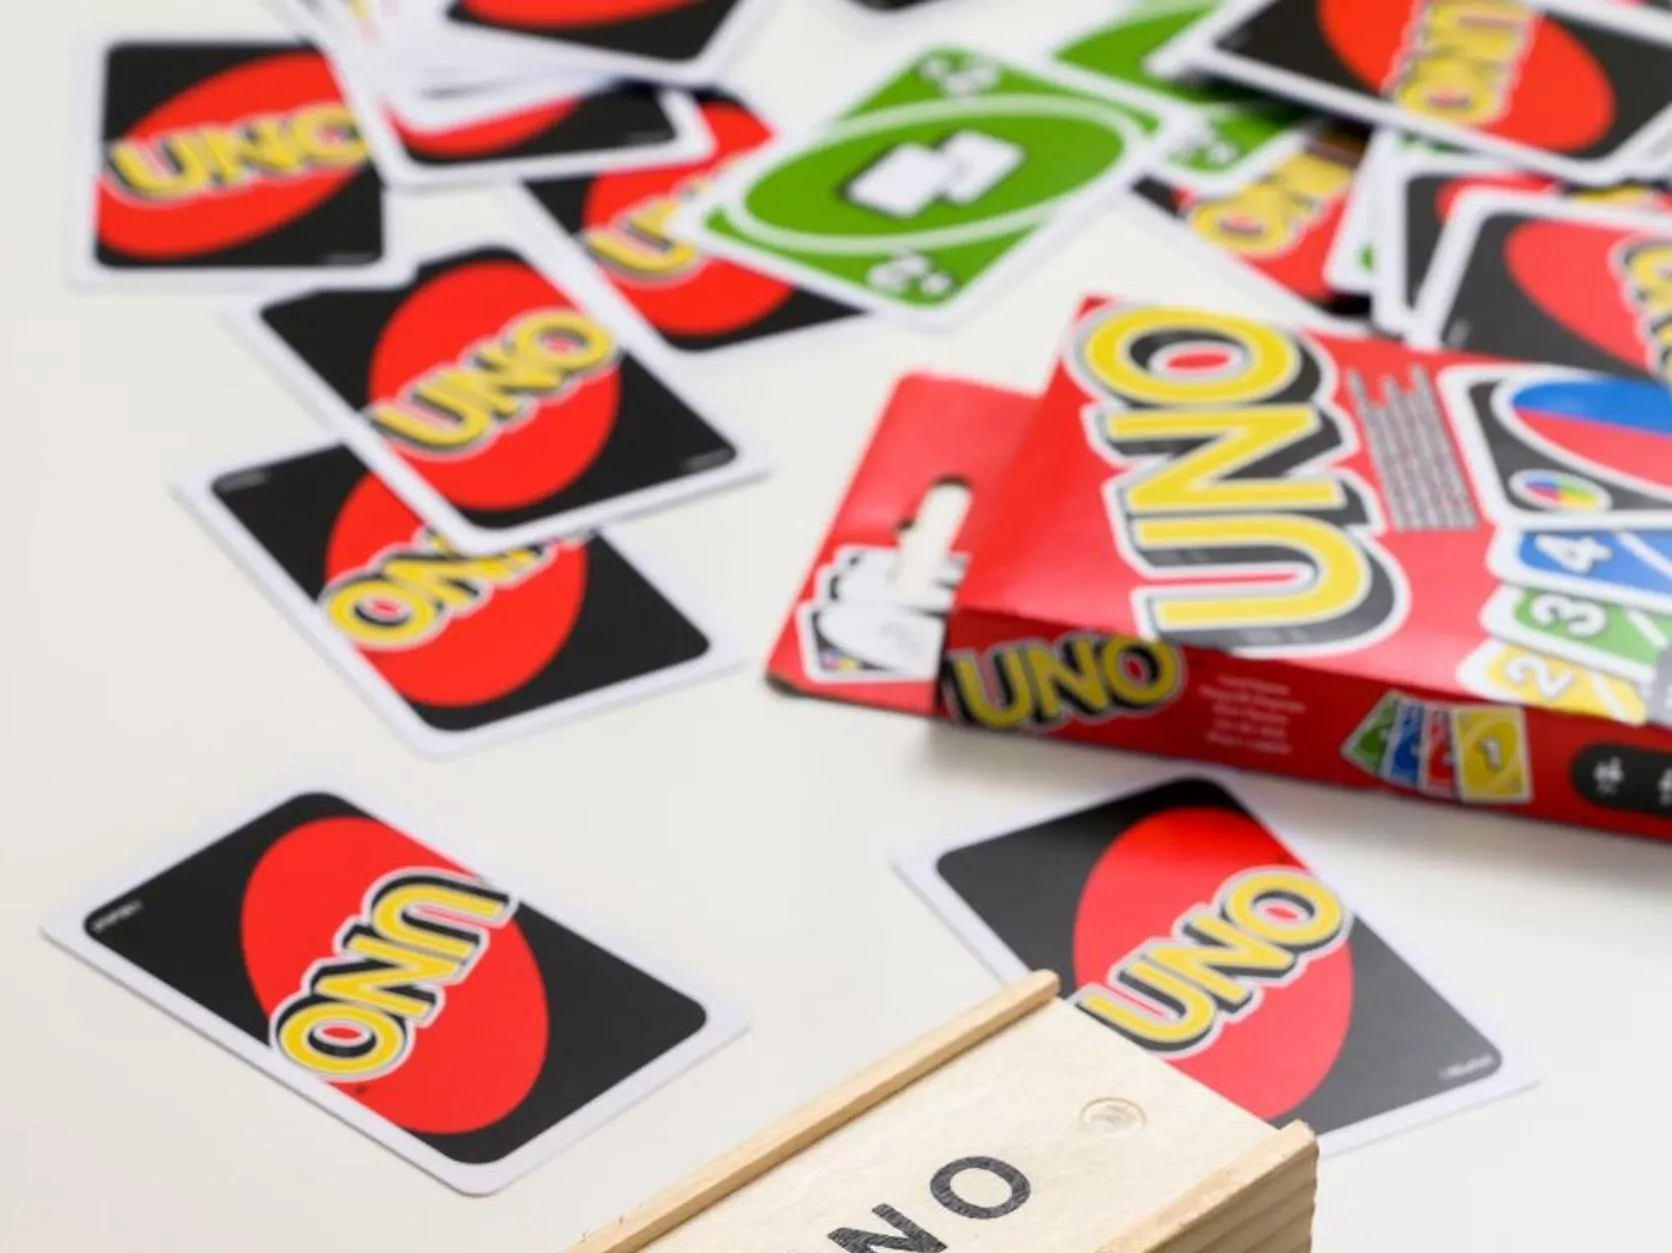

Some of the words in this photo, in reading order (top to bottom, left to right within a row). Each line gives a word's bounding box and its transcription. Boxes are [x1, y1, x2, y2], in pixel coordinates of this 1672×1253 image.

[108, 102, 368, 203] UNO
[360, 304, 618, 460] UNO
[1064, 300, 1410, 658] UNO
[320, 525, 560, 651] NO
[1535, 534, 1612, 575] 4
[1530, 593, 1606, 638] 3
[942, 632, 1186, 733] UNO
[1505, 656, 1574, 698] 2
[270, 866, 522, 1083] UNO
[1068, 864, 1354, 1059] UNO
